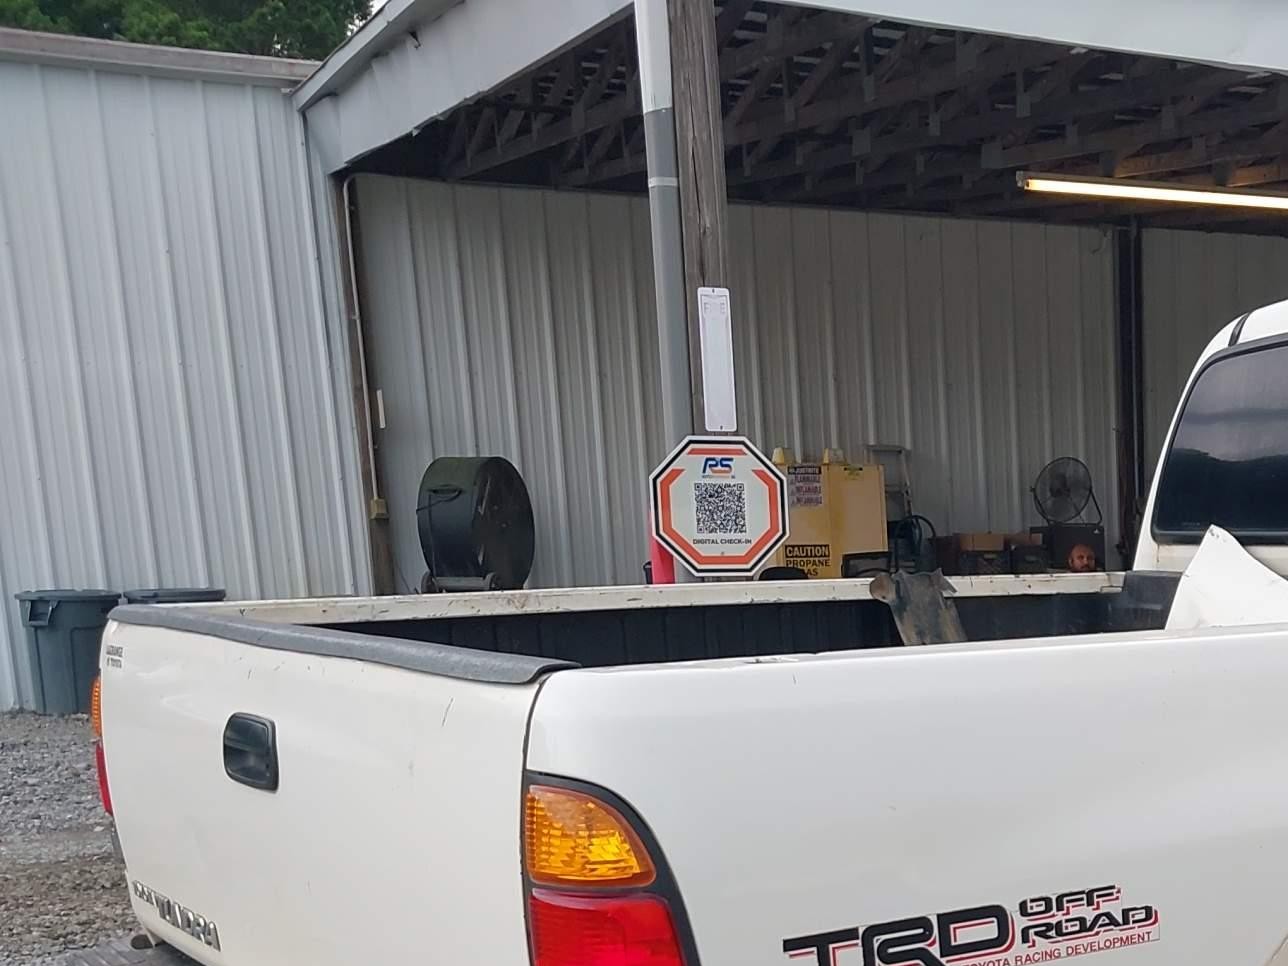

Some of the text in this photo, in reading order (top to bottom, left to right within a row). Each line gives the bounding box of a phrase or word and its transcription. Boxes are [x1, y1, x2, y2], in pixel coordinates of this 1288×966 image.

[786, 546, 829, 557] CAUTION
[786, 558, 831, 568] PROPANE
[1019, 884, 1121, 922] OFF
[1021, 906, 1158, 948] ROAD
[1014, 946, 1062, 966] RACING
[1066, 930, 1152, 956] DEVELOPMENT
